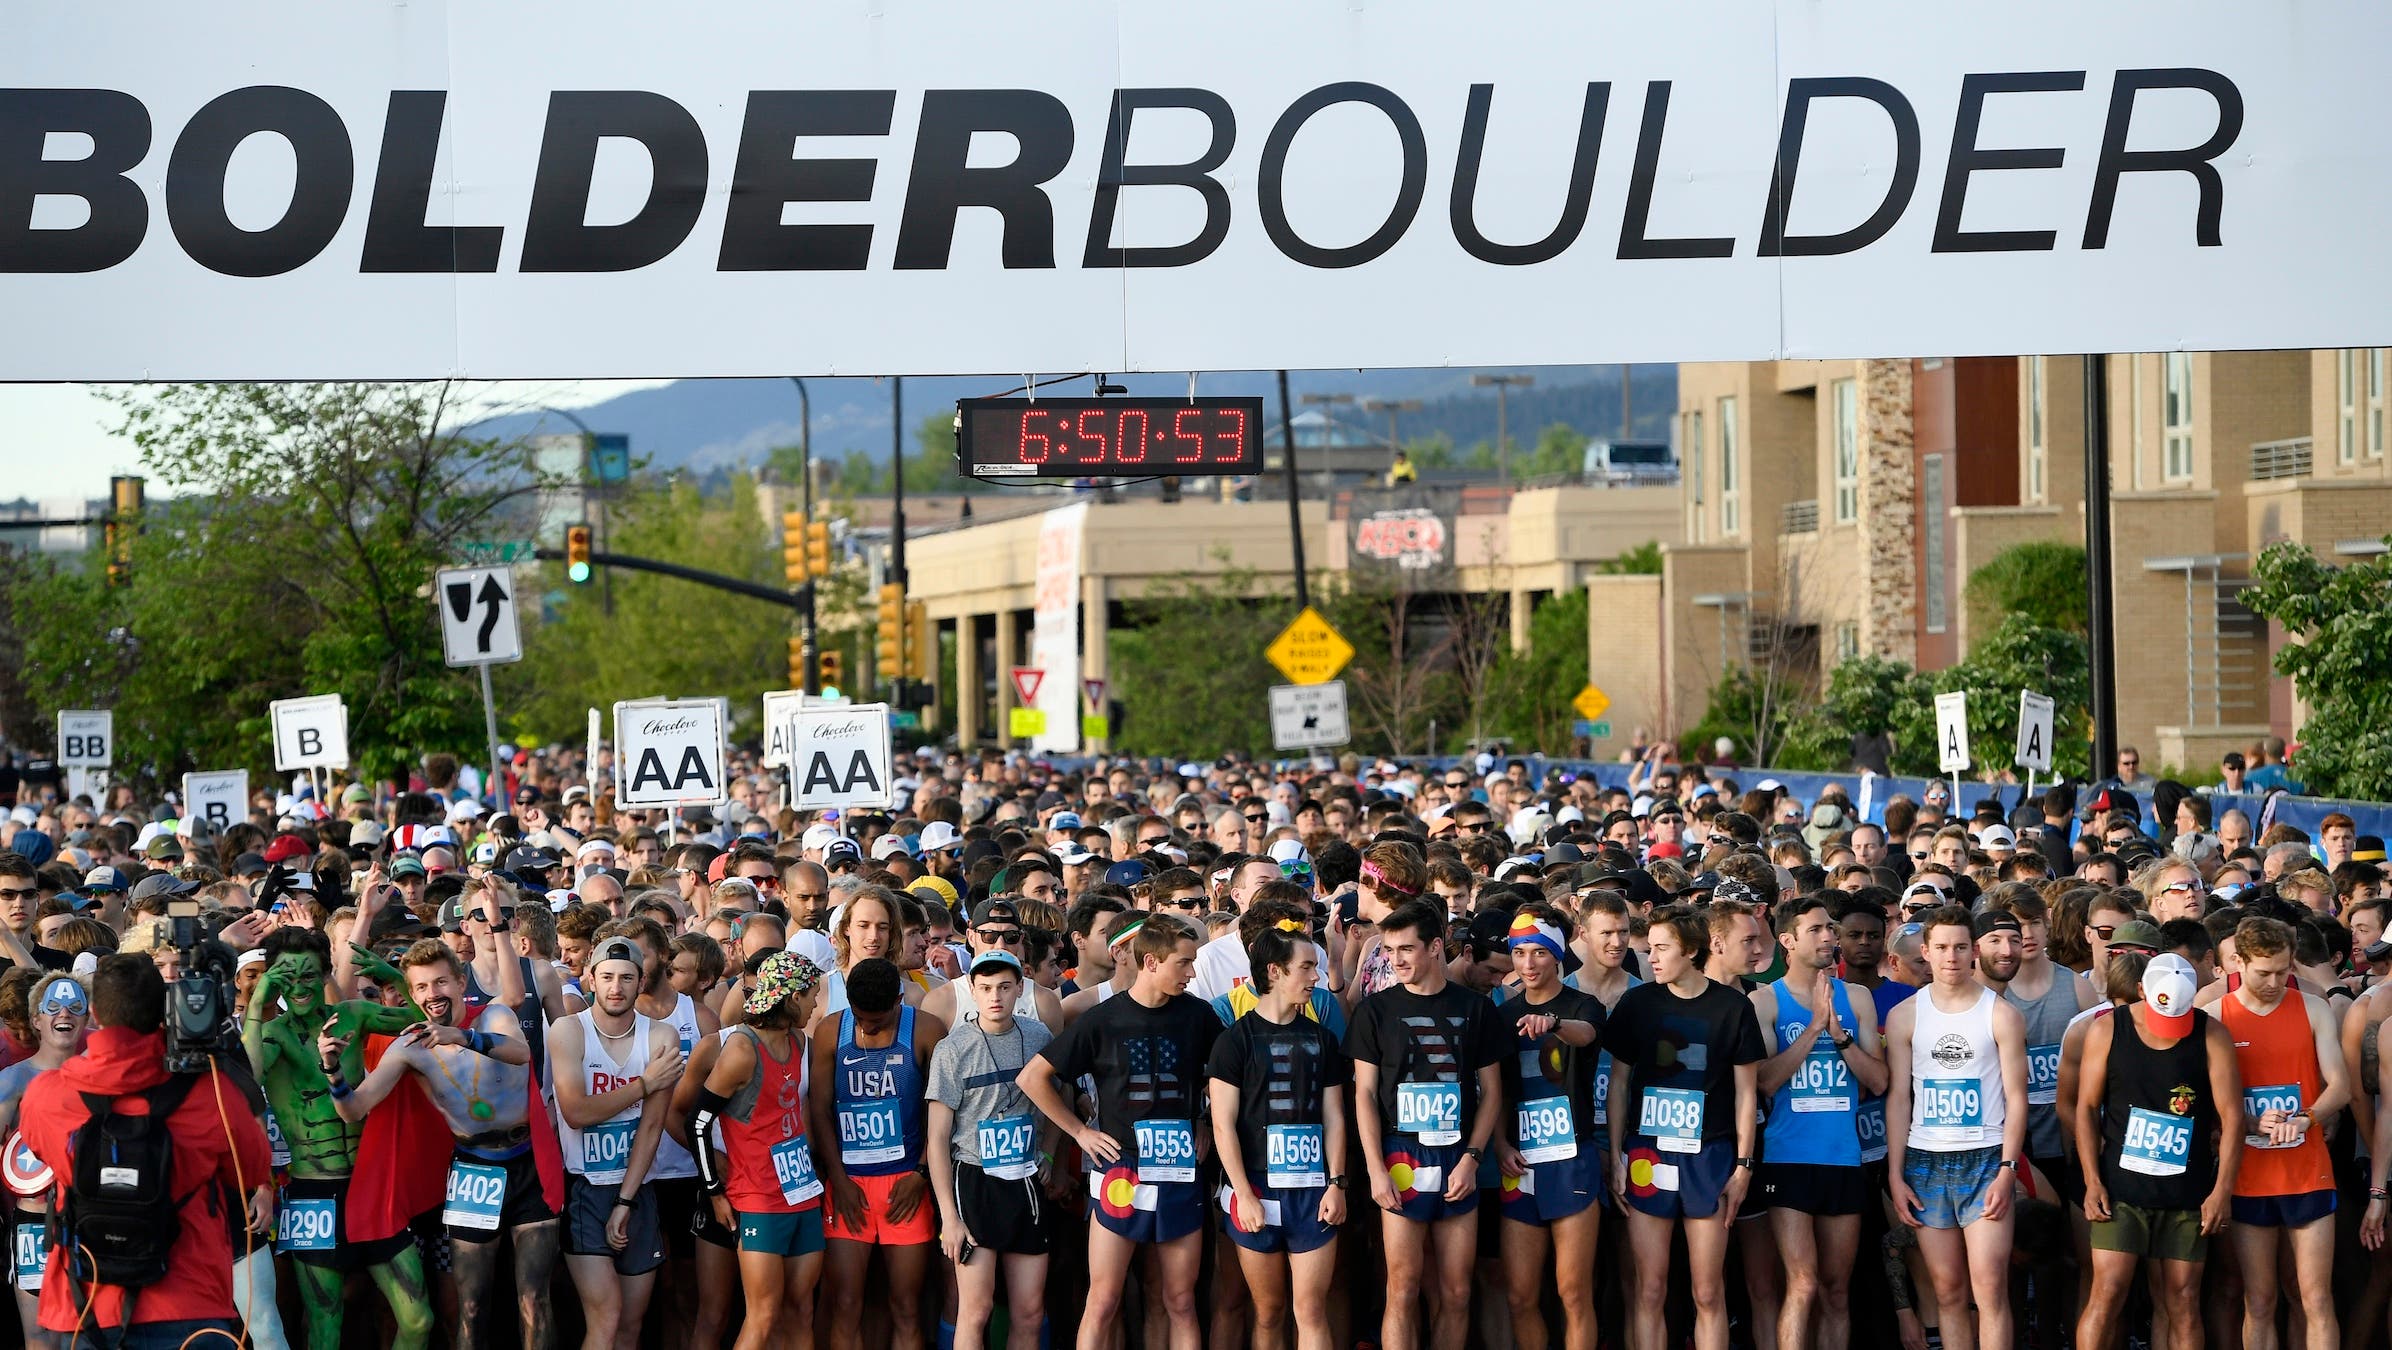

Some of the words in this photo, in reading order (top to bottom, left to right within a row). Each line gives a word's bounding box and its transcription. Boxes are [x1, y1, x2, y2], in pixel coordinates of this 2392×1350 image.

[642, 716, 699, 736] Chocolove
[813, 720, 865, 740] Chocolove
[66, 735, 105, 758] BB
[298, 728, 323, 756] B
[1949, 724, 1959, 759] A
[2026, 723, 2041, 760] A
[631, 746, 714, 791] AA
[802, 750, 881, 794] AA
[206, 802, 229, 829] B
[55, 982, 77, 999] A
[848, 1071, 897, 1097] USA
[1795, 1060, 1848, 1089] A612
[2028, 1054, 2060, 1084] 39
[1402, 1093, 1458, 1122] A042
[1643, 1097, 1701, 1129] A038
[1926, 1089, 1979, 1118] A509
[840, 1109, 896, 1141] A501
[1521, 1107, 1570, 1141] A598
[2129, 1119, 2190, 1156] A545
[981, 1124, 1034, 1159] A247
[1139, 1129, 1193, 1158] A553
[1272, 1134, 1320, 1164] A569
[776, 1145, 812, 1184] A505
[447, 1170, 503, 1205] A402
[280, 1209, 333, 1240] A290
[22, 1233, 51, 1264] A3
